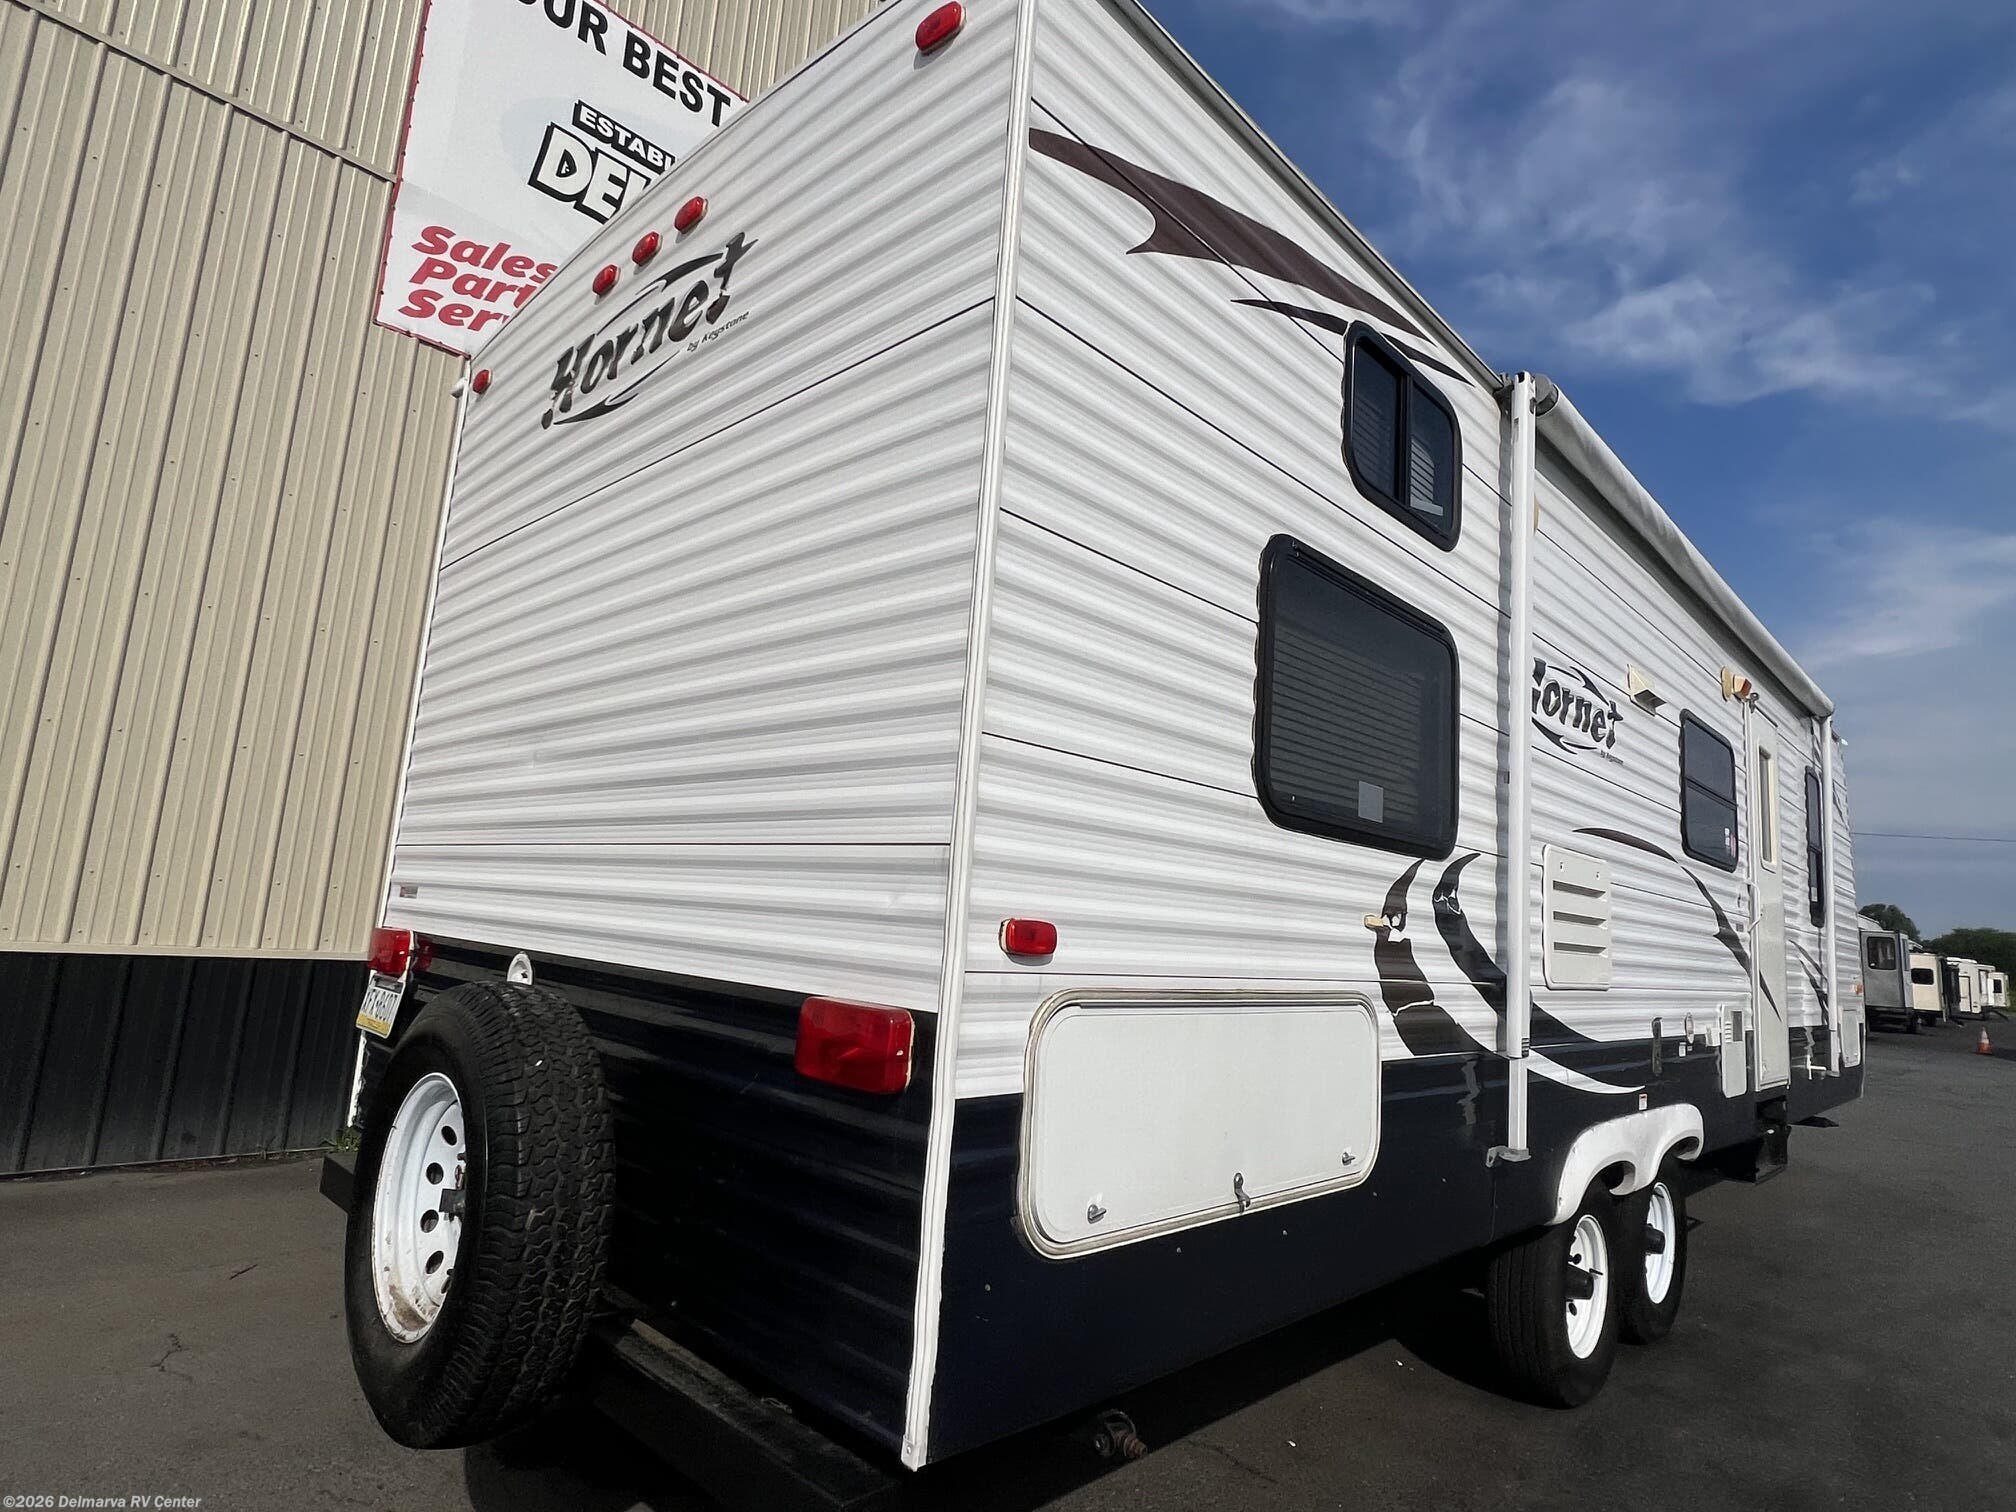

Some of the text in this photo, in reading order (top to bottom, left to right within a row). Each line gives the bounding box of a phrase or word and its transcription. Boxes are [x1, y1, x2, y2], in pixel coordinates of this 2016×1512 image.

[516, 0, 731, 127] UR BEST
[409, 257, 537, 309] Part
[411, 226, 558, 284] Sales
[398, 289, 510, 332] Ser
[541, 232, 758, 430] Hornet
